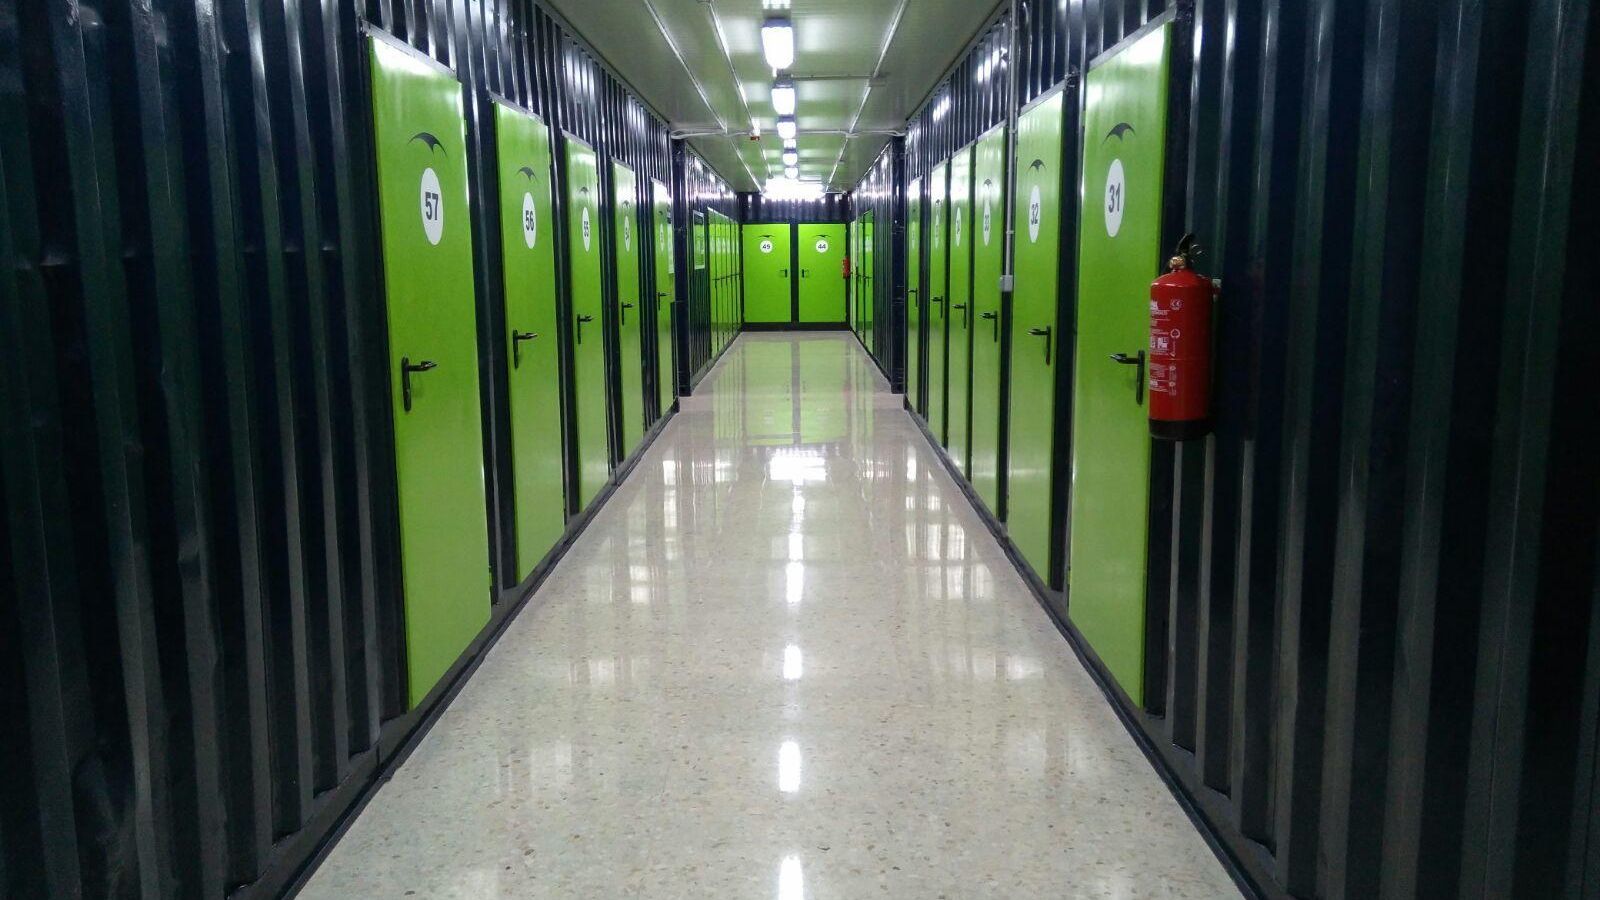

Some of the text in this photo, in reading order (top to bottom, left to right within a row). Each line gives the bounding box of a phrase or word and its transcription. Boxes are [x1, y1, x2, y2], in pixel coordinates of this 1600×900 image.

[425, 191, 439, 221] 57
[1108, 182, 1121, 213] 31
[525, 210, 535, 231] 56
[1031, 203, 1039, 225] 32
